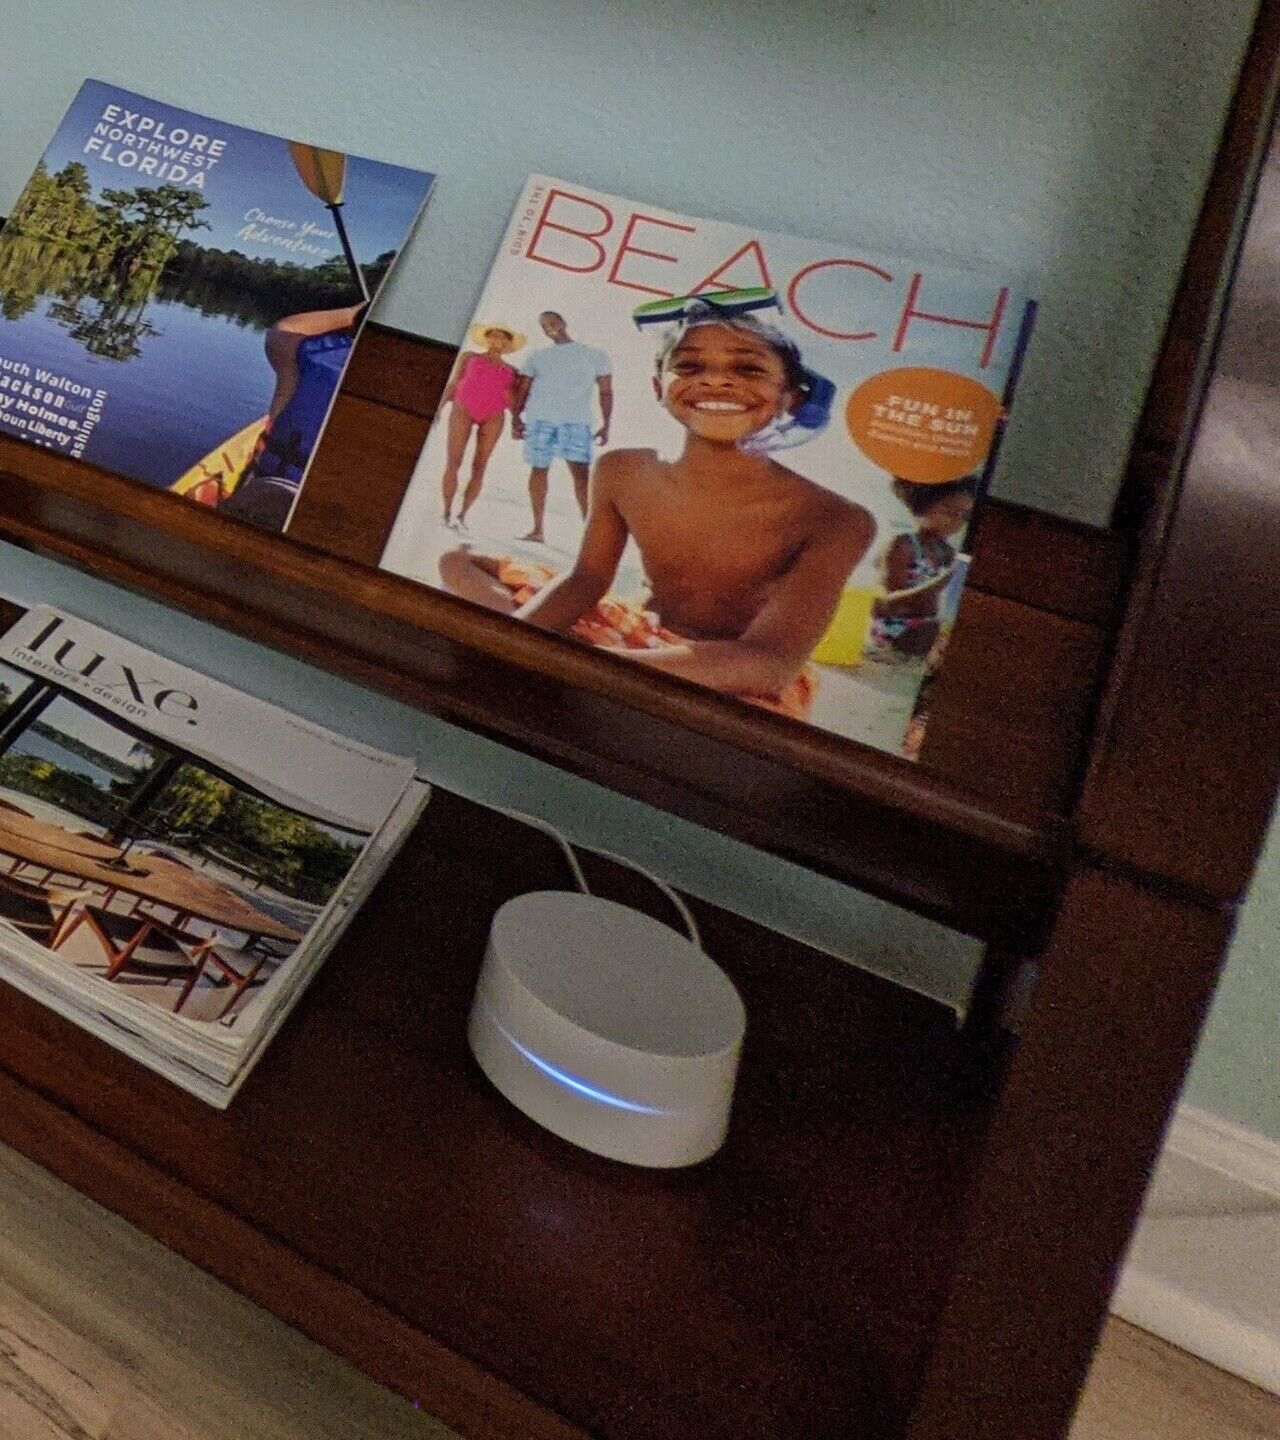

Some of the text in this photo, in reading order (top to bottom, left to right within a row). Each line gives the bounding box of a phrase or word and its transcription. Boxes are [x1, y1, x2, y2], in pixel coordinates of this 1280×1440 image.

[94, 122, 219, 170] NORTHWEST
[101, 104, 228, 157] EXPLORE
[82, 136, 207, 189] FLORIDA
[526, 188, 1010, 370] BEACH
[35, 368, 92, 399] Walton
[16, 398, 80, 431] Holmes
[70, 389, 108, 458] ashington
[872, 403, 921, 428] THE
[929, 417, 979, 436] SUN
[884, 394, 974, 421] FUN IN
[28, 420, 71, 446] Liberty
[92, 686, 148, 717] design
